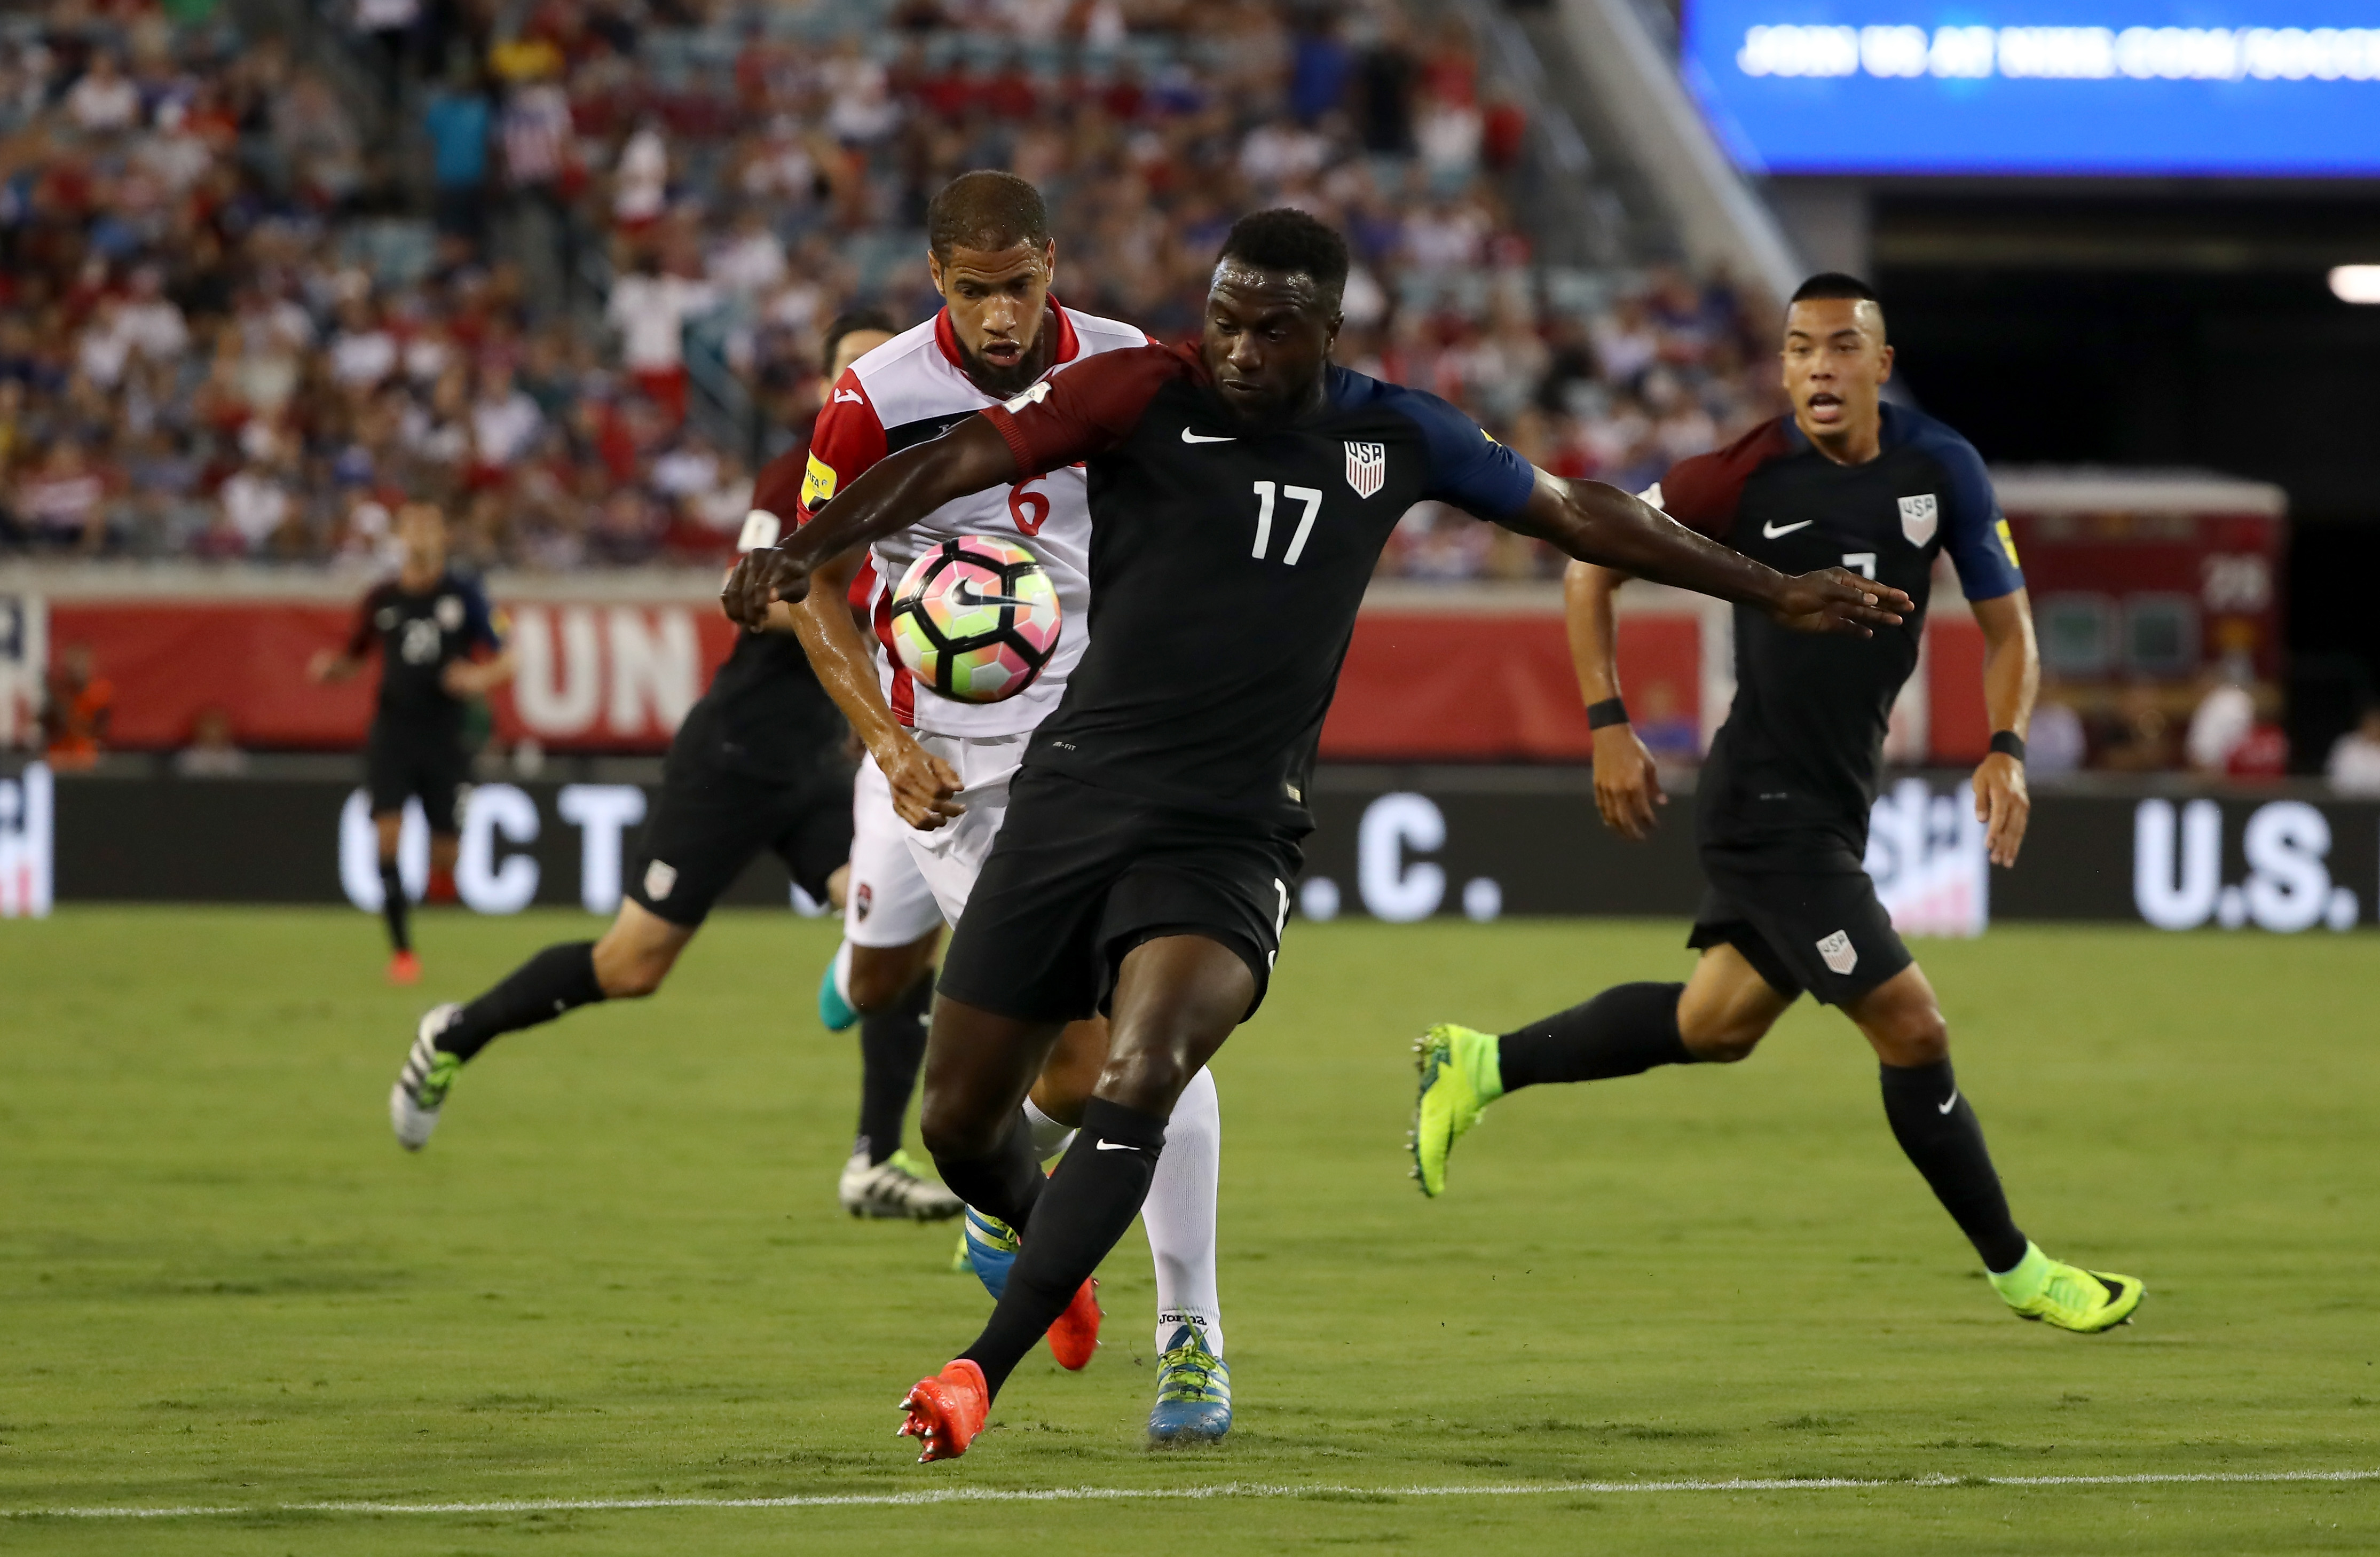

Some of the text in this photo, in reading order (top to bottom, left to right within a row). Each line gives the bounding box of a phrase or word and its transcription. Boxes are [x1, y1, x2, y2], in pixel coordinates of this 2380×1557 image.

[1347, 441, 1382, 463] USA
[807, 469, 819, 488] FIFA
[1008, 474, 1050, 536] 6
[1252, 481, 1322, 565] 17
[1903, 498, 1933, 517] USA
[1299, 791, 1503, 923] .C.
[2134, 798, 2360, 932] U.S.
[1159, 1314, 1207, 1325] Joma
